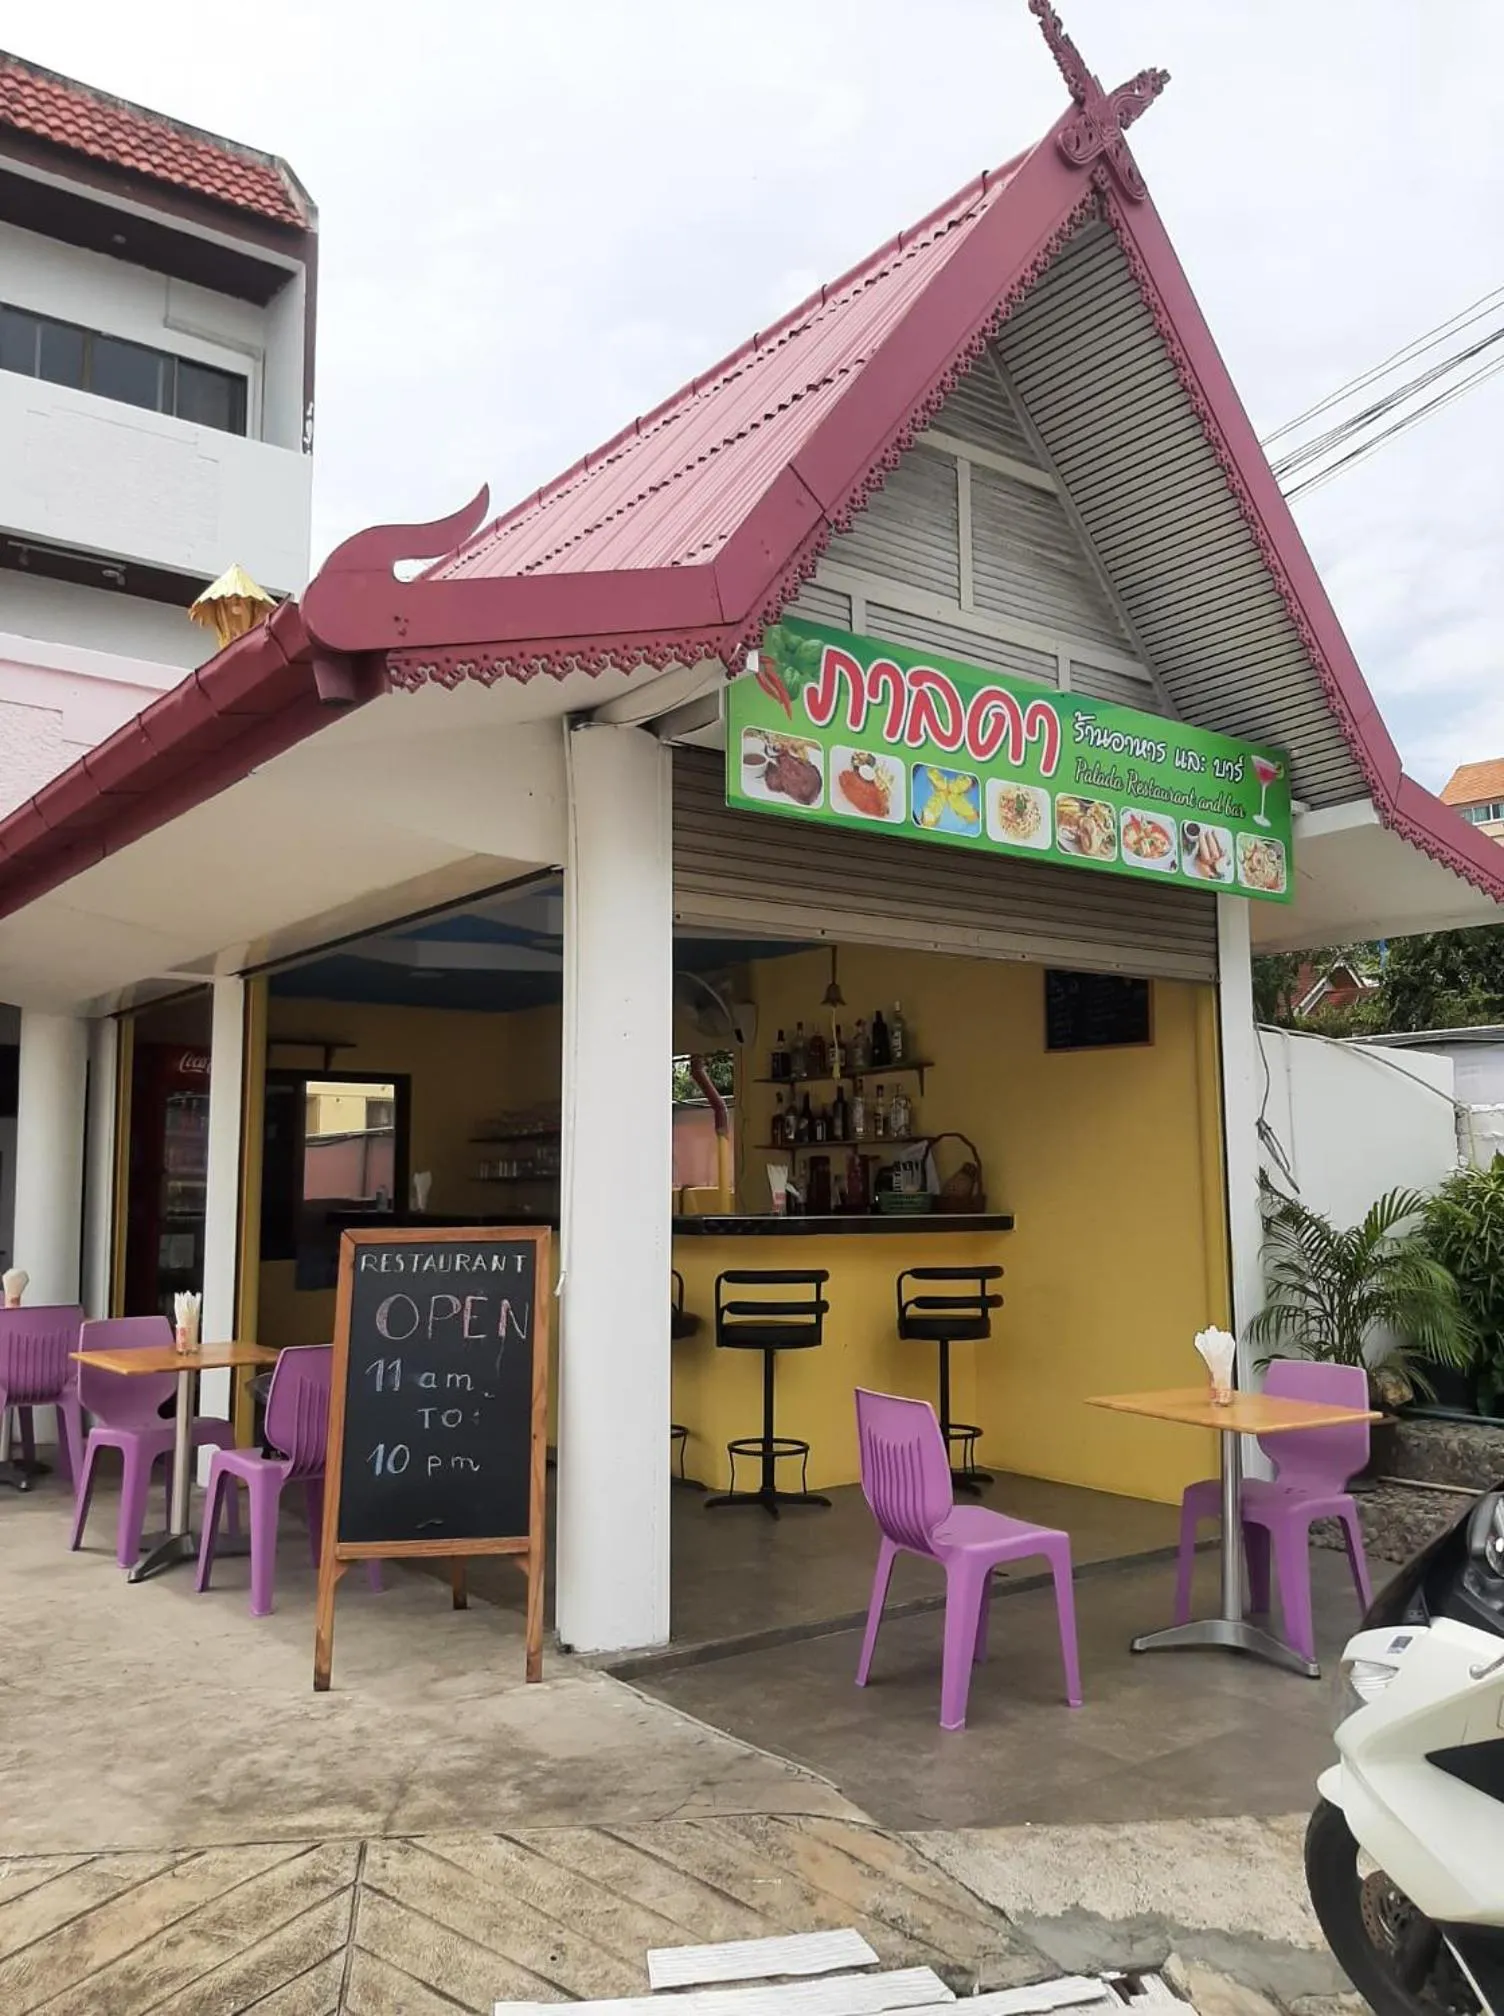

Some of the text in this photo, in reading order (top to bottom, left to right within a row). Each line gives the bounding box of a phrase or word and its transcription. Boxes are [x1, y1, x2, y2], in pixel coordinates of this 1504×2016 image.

[1073, 711, 1245, 783] ร้านอาหาร และ บาร์
[1074, 756, 1247, 819] Palada Restaurant and bar
[360, 1253, 528, 1274] RESTAURANT
[375, 1292, 530, 1341] OPEN
[364, 1357, 402, 1392] 11
[366, 1442, 481, 1477] 10 pm
